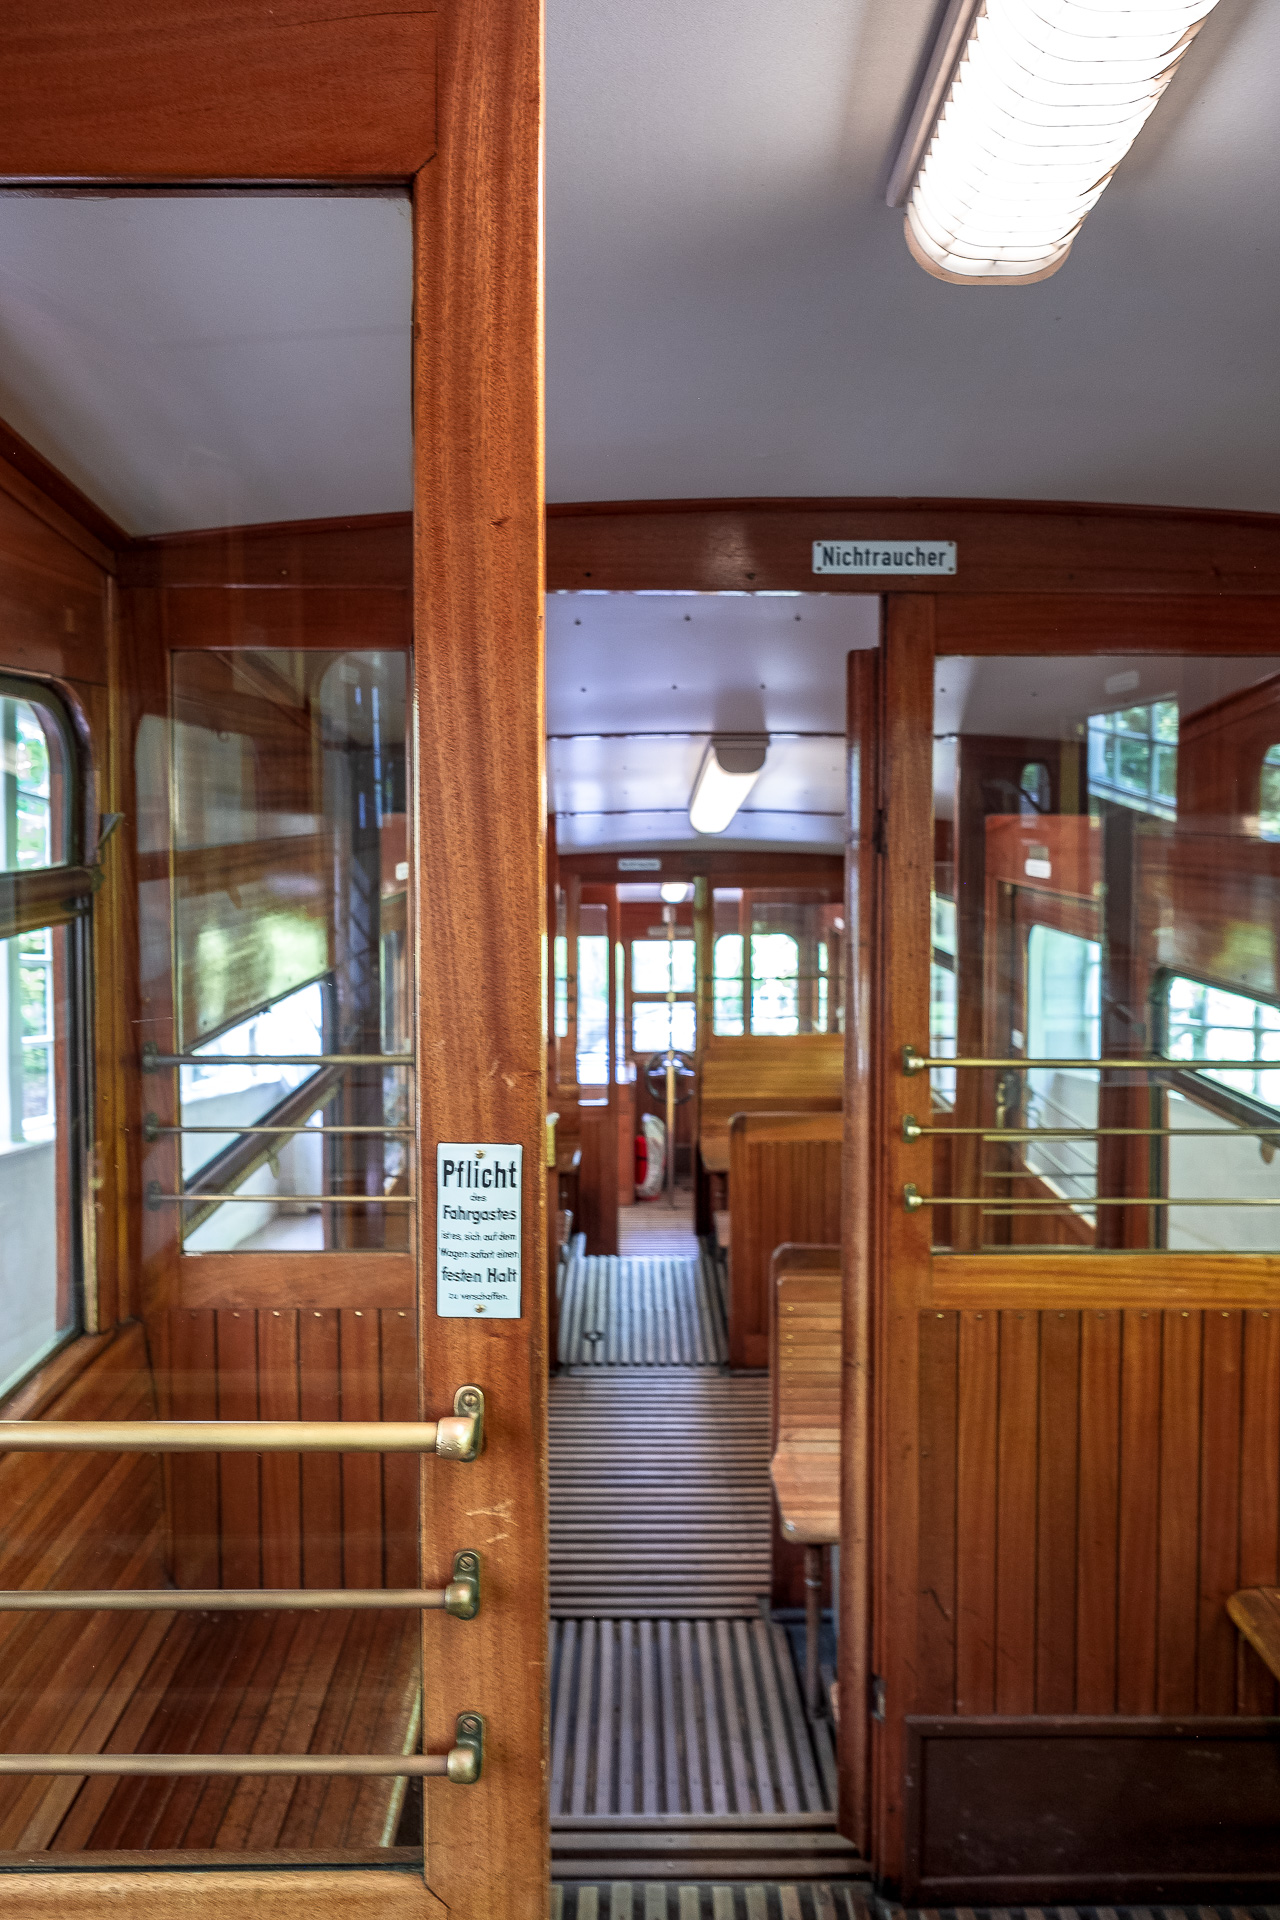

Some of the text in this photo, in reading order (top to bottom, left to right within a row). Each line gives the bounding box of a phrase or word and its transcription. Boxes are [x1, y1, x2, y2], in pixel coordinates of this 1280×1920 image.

[822, 546, 946, 566] Nichtraucher
[442, 1160, 517, 1188] Pflicht
[470, 1192, 487, 1201] des
[443, 1205, 517, 1224] Fahrgastes
[464, 1231, 481, 1241] sich
[483, 1231, 497, 1241] auf
[439, 1248, 468, 1260] Wagen
[496, 1249, 519, 1259] einen
[442, 1266, 517, 1283] festen Halt
